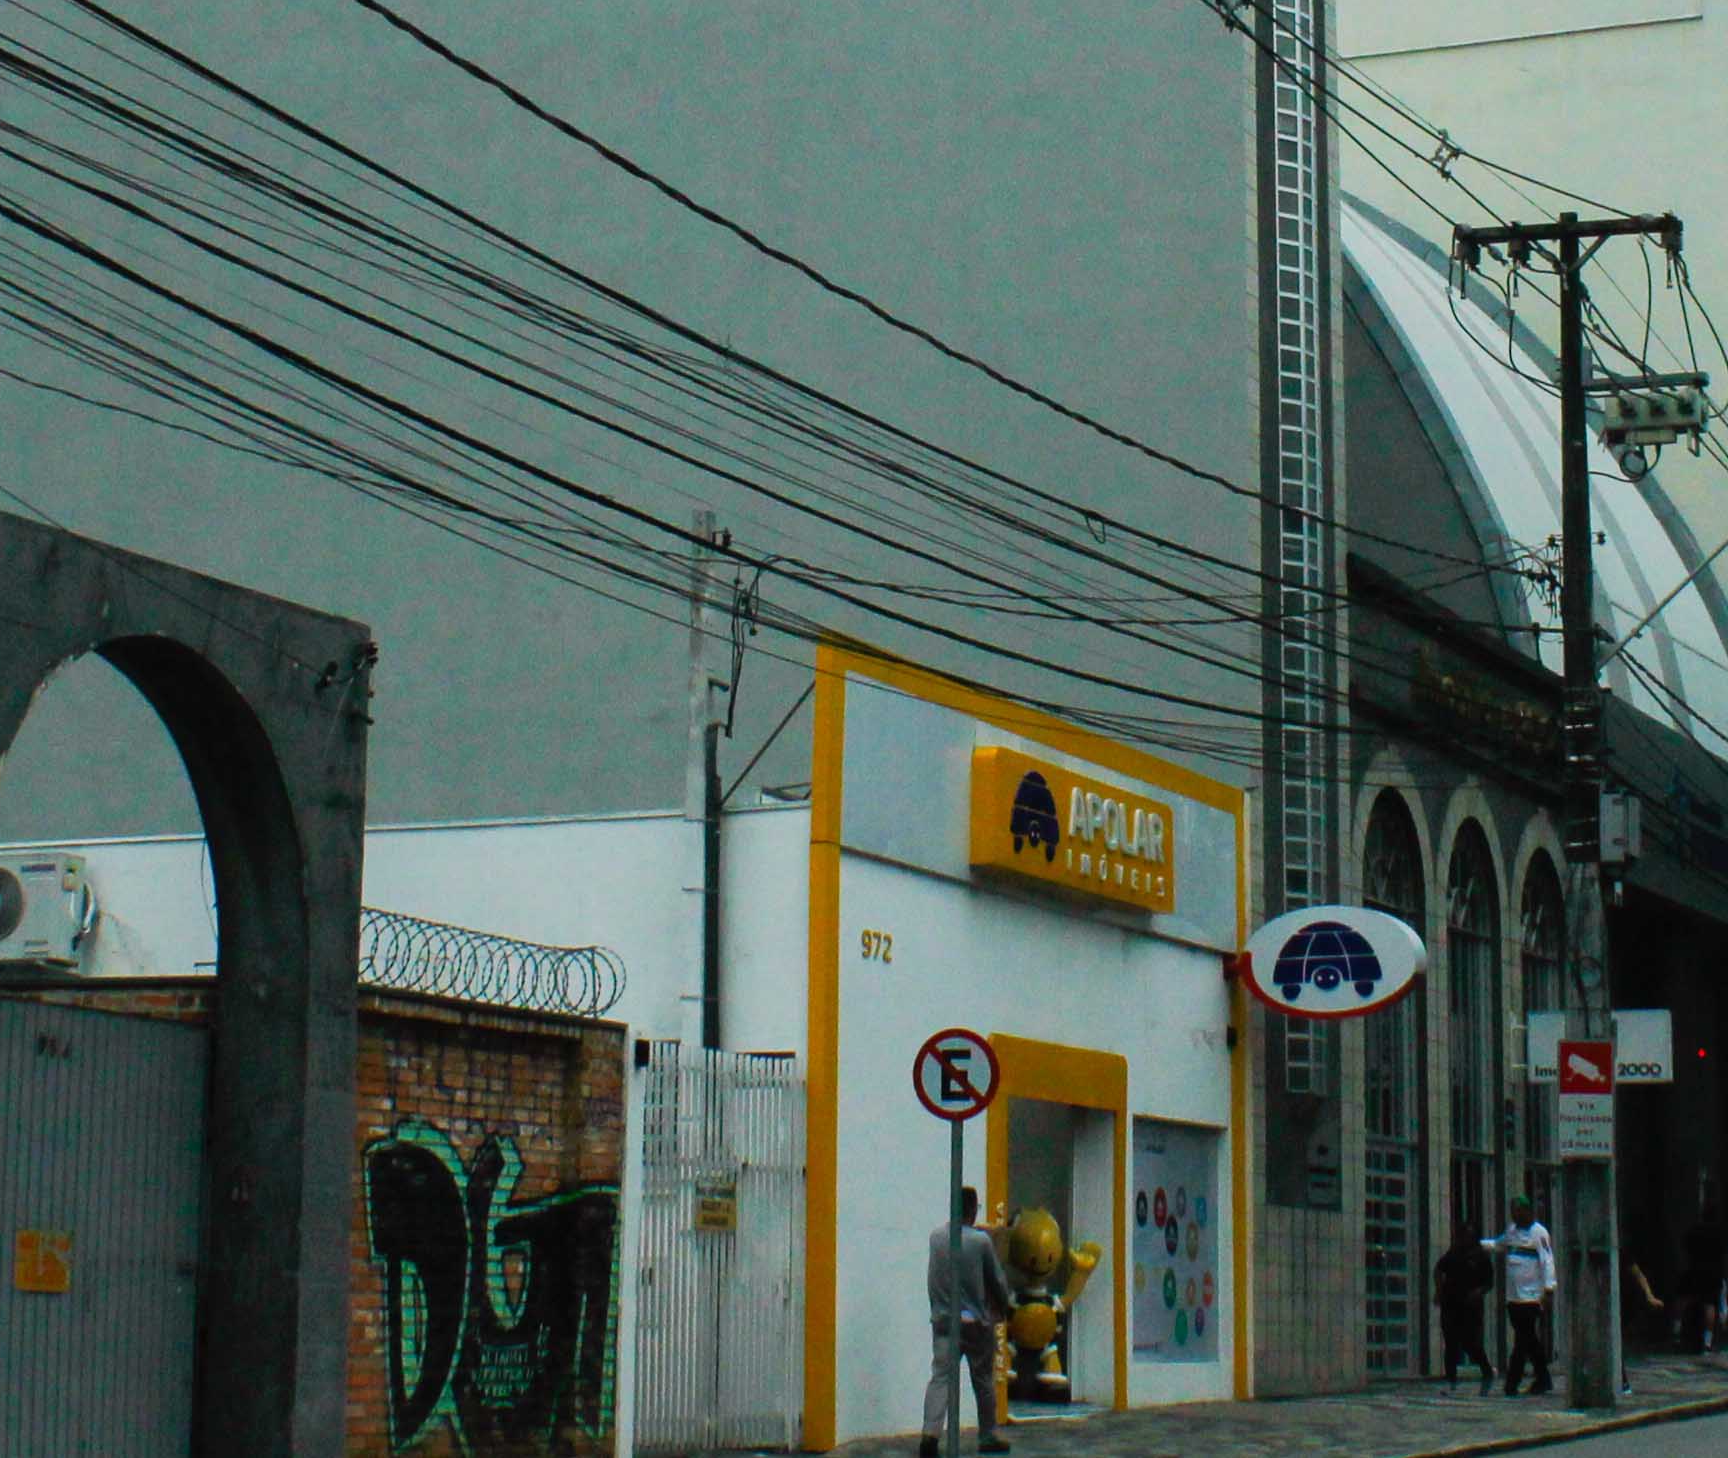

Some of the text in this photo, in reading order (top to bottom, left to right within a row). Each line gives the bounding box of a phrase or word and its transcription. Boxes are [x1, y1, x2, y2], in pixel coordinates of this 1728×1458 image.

[1068, 786, 1165, 863] APOLAR
[861, 928, 894, 964] 972
[1617, 1063, 1662, 1077] 2000
